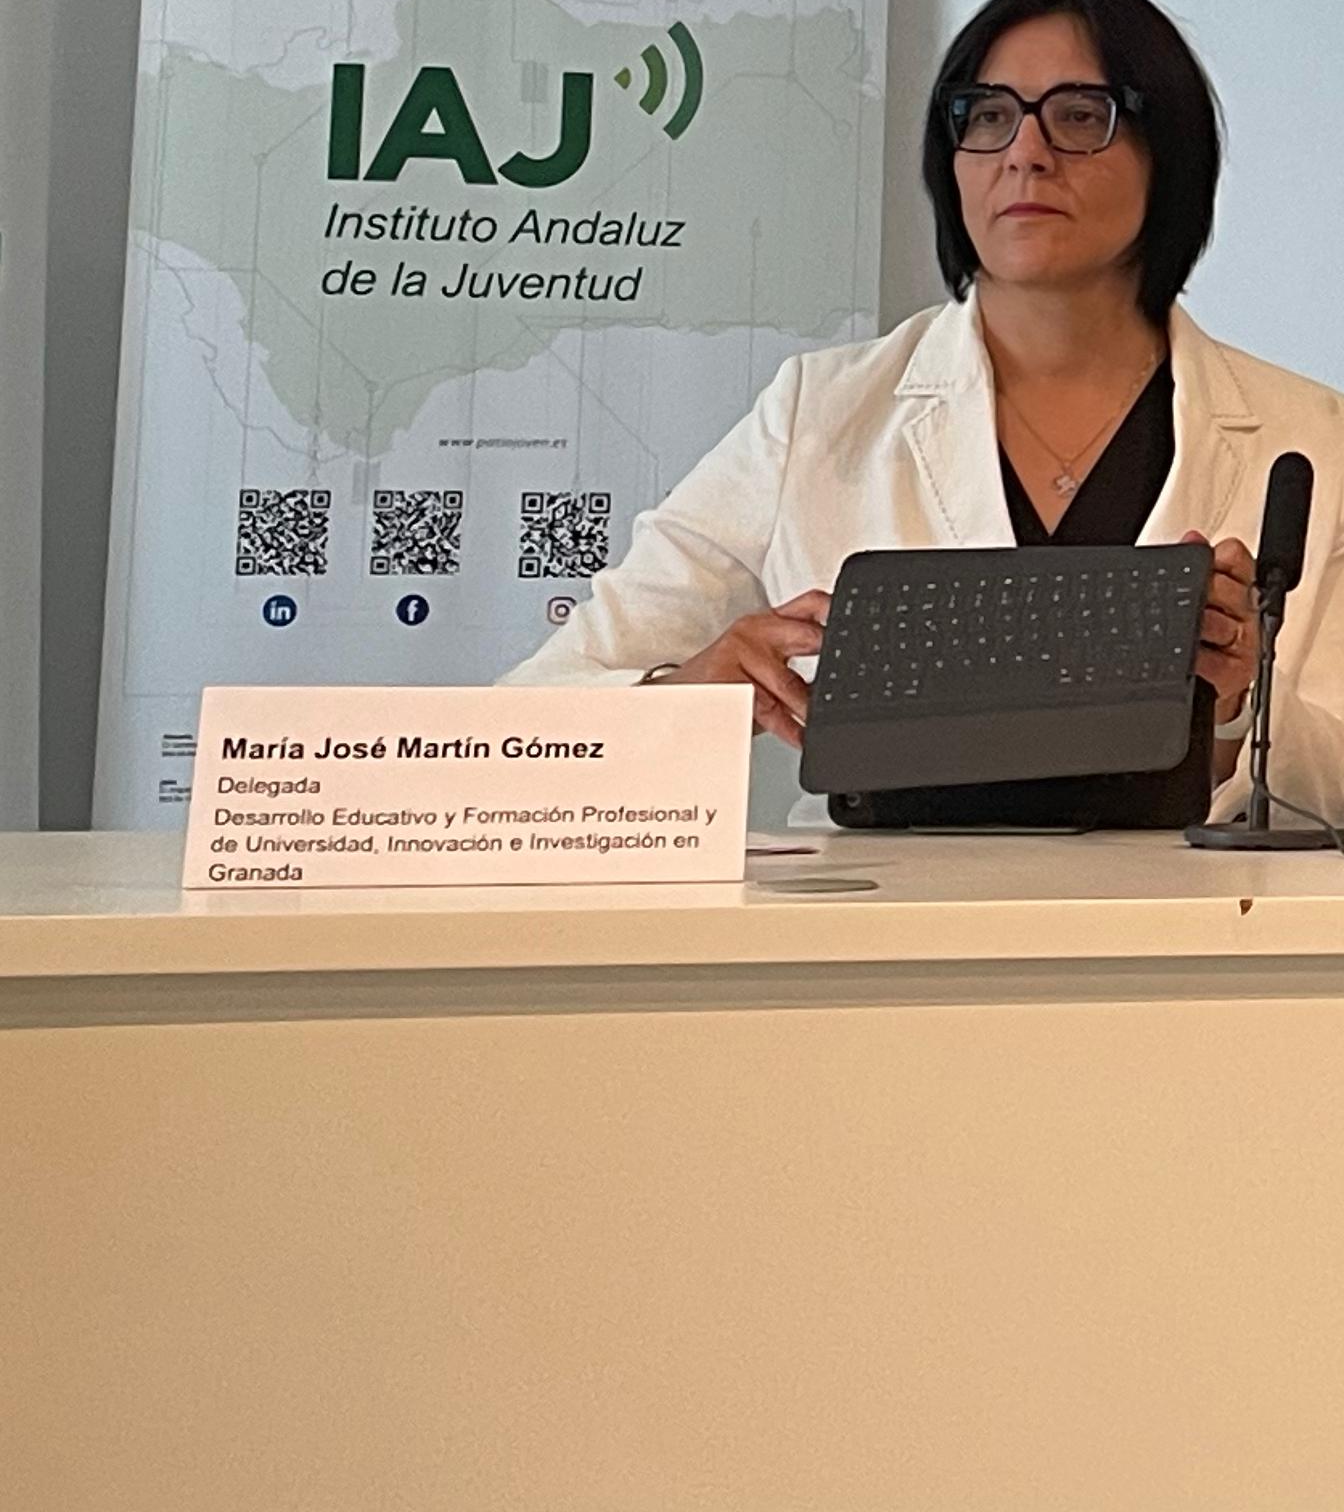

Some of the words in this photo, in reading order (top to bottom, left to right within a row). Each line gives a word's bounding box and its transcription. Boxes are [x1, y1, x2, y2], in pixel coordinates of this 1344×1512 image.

[327, 63, 594, 189] IAJ
[324, 203, 498, 243] Instituto
[508, 209, 686, 247] Andaluz
[321, 260, 377, 296] de
[391, 261, 427, 297] la
[441, 263, 643, 302] Juventud
[222, 736, 305, 760] María
[314, 736, 387, 760] José
[396, 736, 490, 759] Martín
[501, 736, 604, 759] Gómez
[217, 776, 321, 798] Delegada
[214, 808, 325, 826] Desarrollo
[332, 807, 438, 826] Educativo
[444, 812, 456, 829] y
[463, 806, 575, 824] Formación
[581, 805, 699, 823] Profesional
[705, 809, 717, 826] y
[210, 835, 238, 853] de
[245, 835, 378, 854] Universidad,
[387, 835, 503, 853] Innovación
[509, 837, 523, 852] e
[529, 832, 667, 854] Investigación
[673, 835, 700, 849] en
[208, 863, 303, 882] Granada
